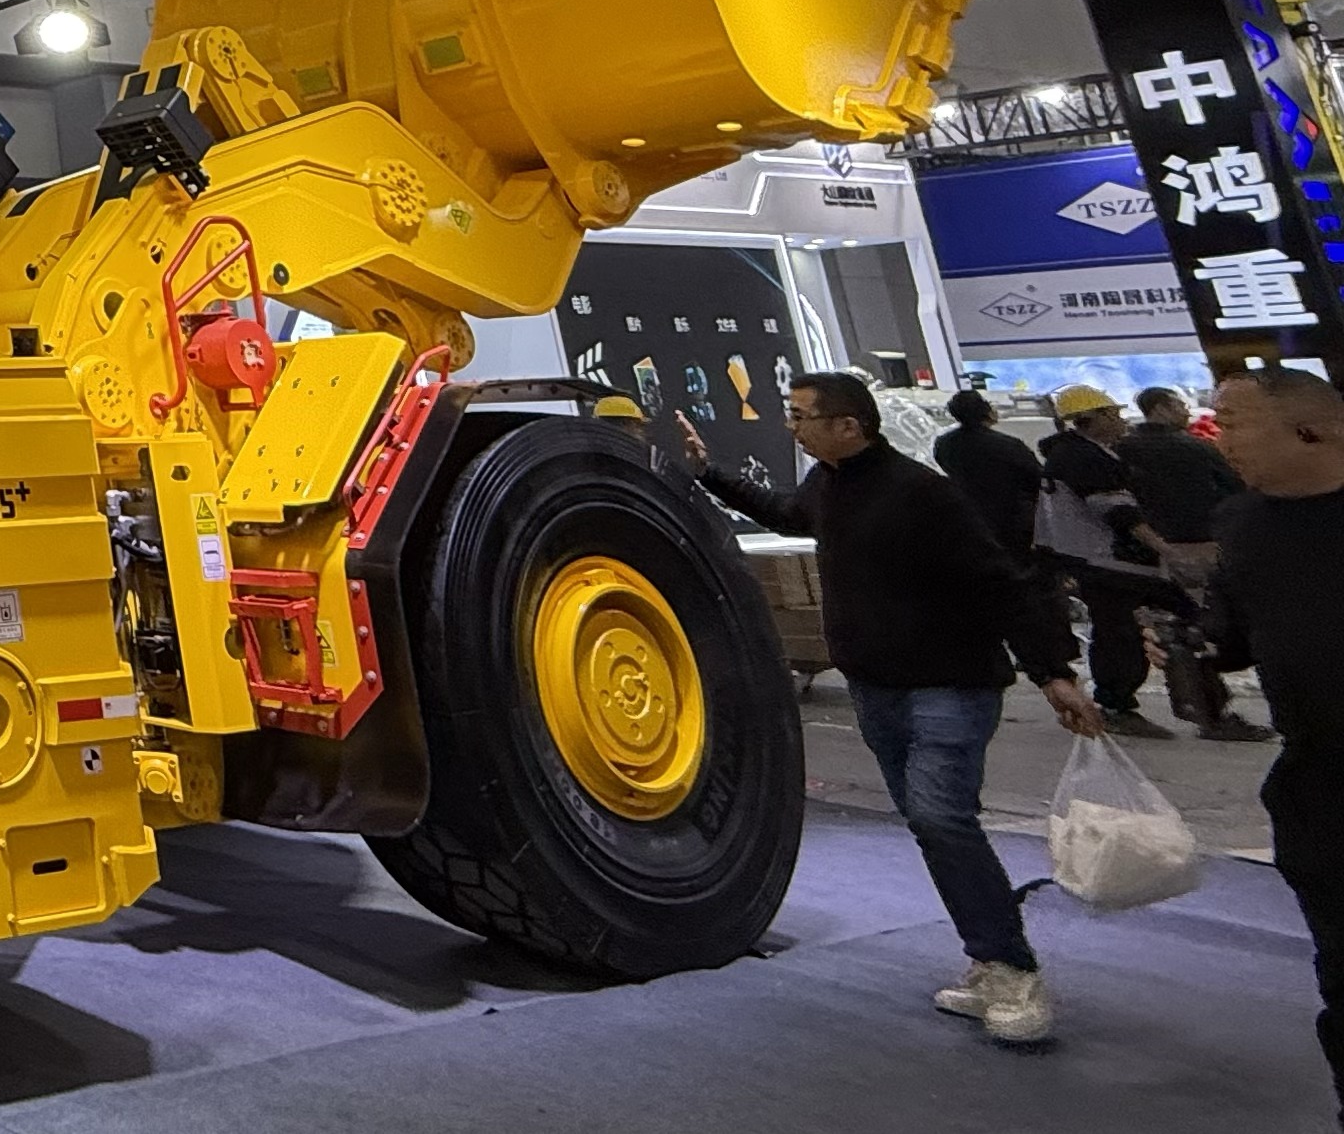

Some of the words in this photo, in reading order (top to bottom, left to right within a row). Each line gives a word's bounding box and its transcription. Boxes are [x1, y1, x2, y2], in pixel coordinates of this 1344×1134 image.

[1078, 197, 1154, 219] TSZZ
[1134, 51, 1329, 381] 中鸿重
[993, 303, 1038, 316] TSZZ
